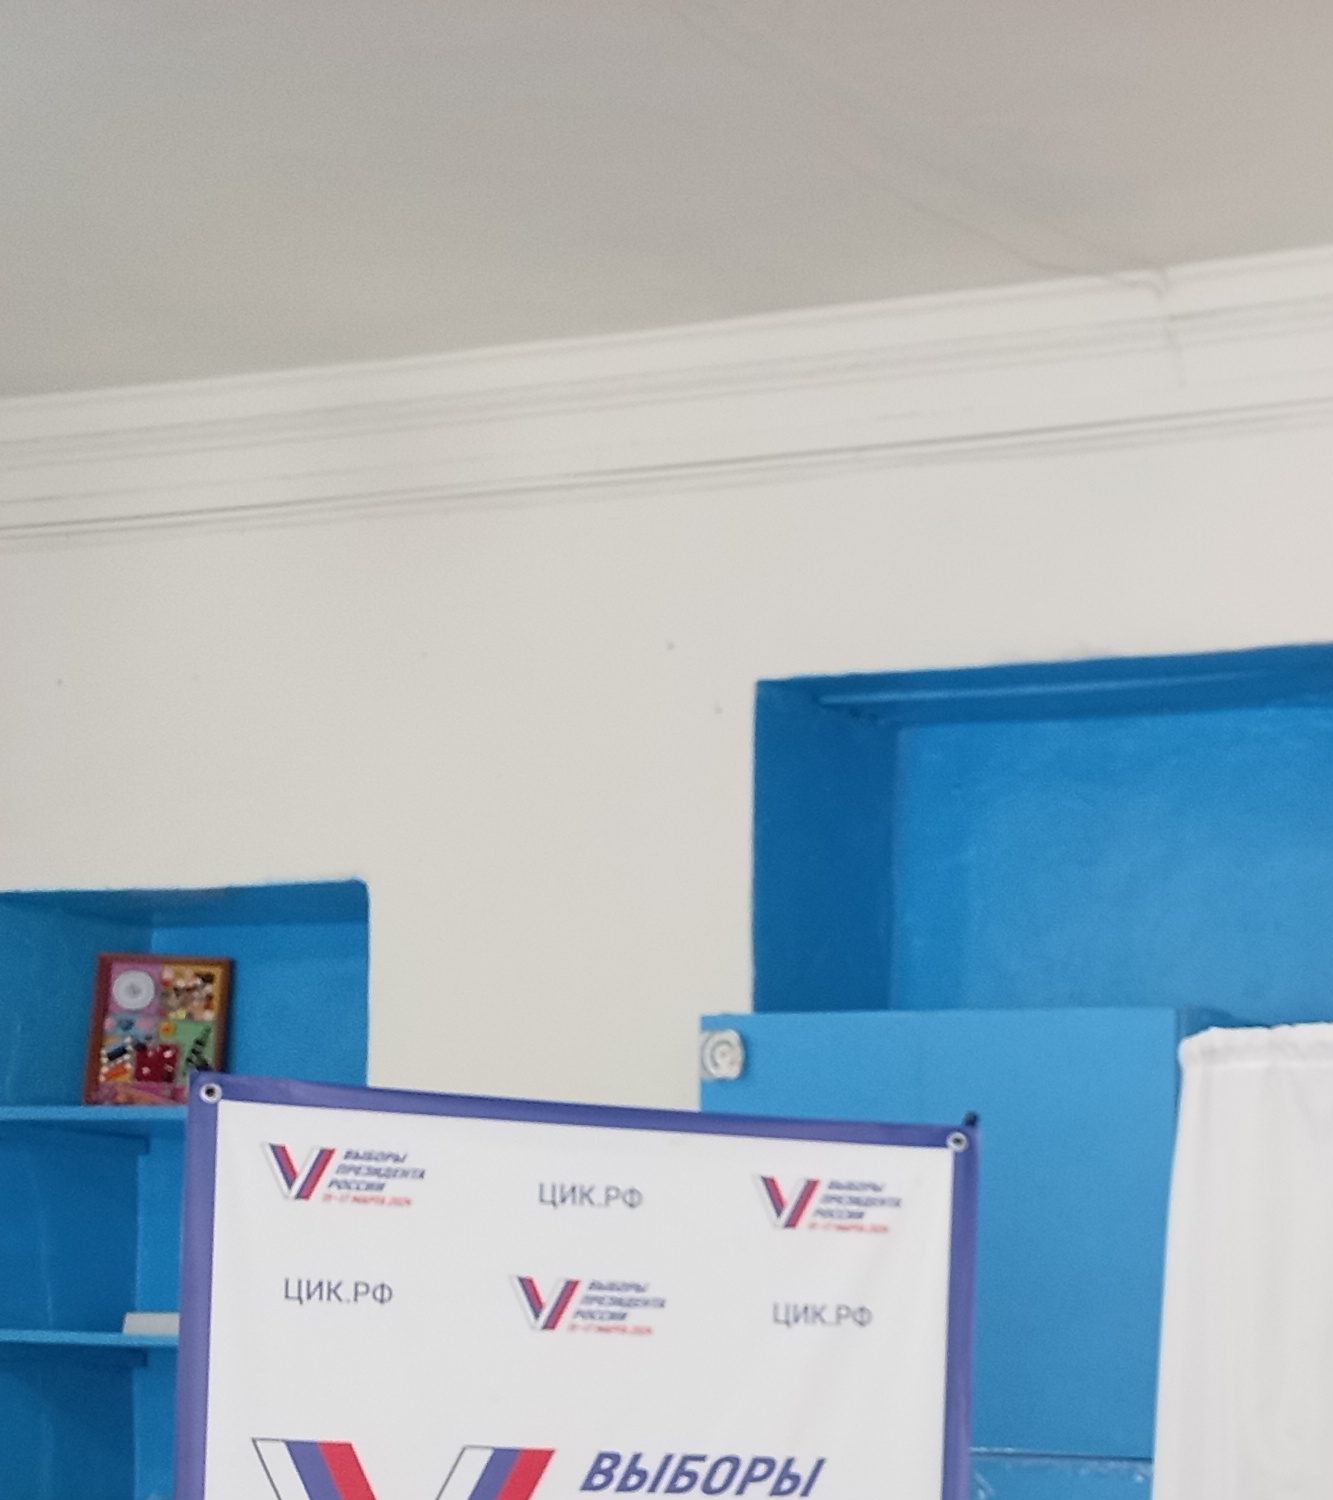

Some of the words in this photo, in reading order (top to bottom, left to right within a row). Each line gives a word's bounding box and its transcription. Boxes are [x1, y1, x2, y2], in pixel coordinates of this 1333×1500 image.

[539, 1183, 642, 1209] ЦИК.РФ
[284, 1278, 393, 1305] ЦИК.РФ
[773, 1304, 872, 1327] ЦИК.РФ
[579, 1451, 826, 1498] ВЫБОРЫ
